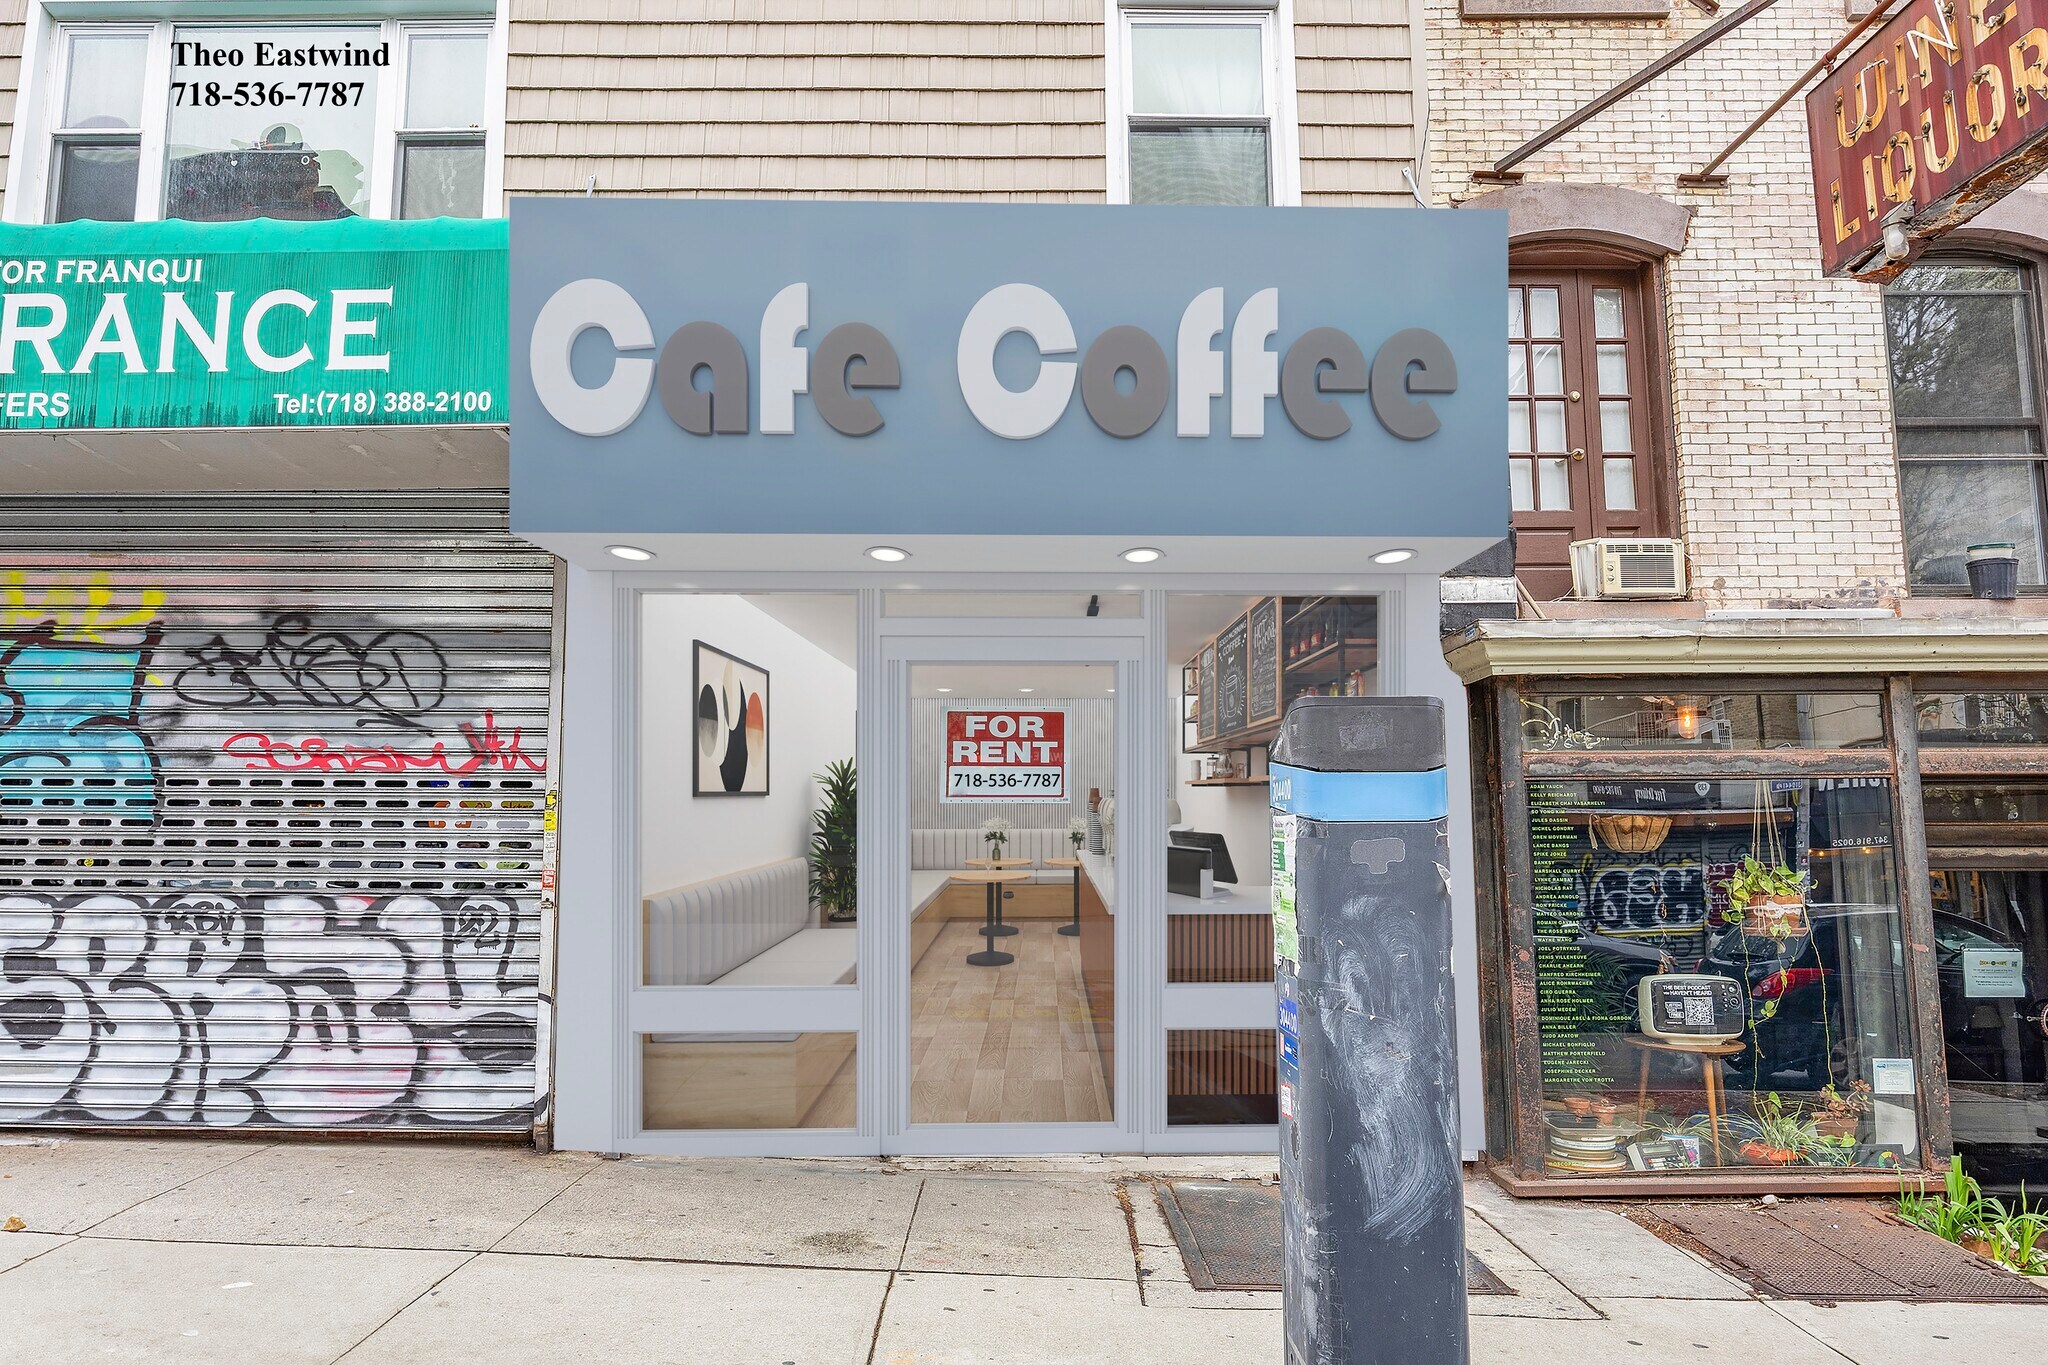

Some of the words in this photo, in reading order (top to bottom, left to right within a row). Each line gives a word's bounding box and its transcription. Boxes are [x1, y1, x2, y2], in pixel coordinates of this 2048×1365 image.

[0, 260, 47, 285] OR
[55, 259, 203, 286] FRANQUI
[0, 286, 394, 374] RANCE
[529, 278, 902, 438] Cafe
[956, 282, 1459, 442] Coffee
[273, 390, 376, 416] Tel:(718)
[384, 391, 492, 412] 388-2100
[965, 715, 1045, 738] FOR
[952, 741, 1058, 763] RENT
[954, 773, 1061, 788] 718-536-7787
